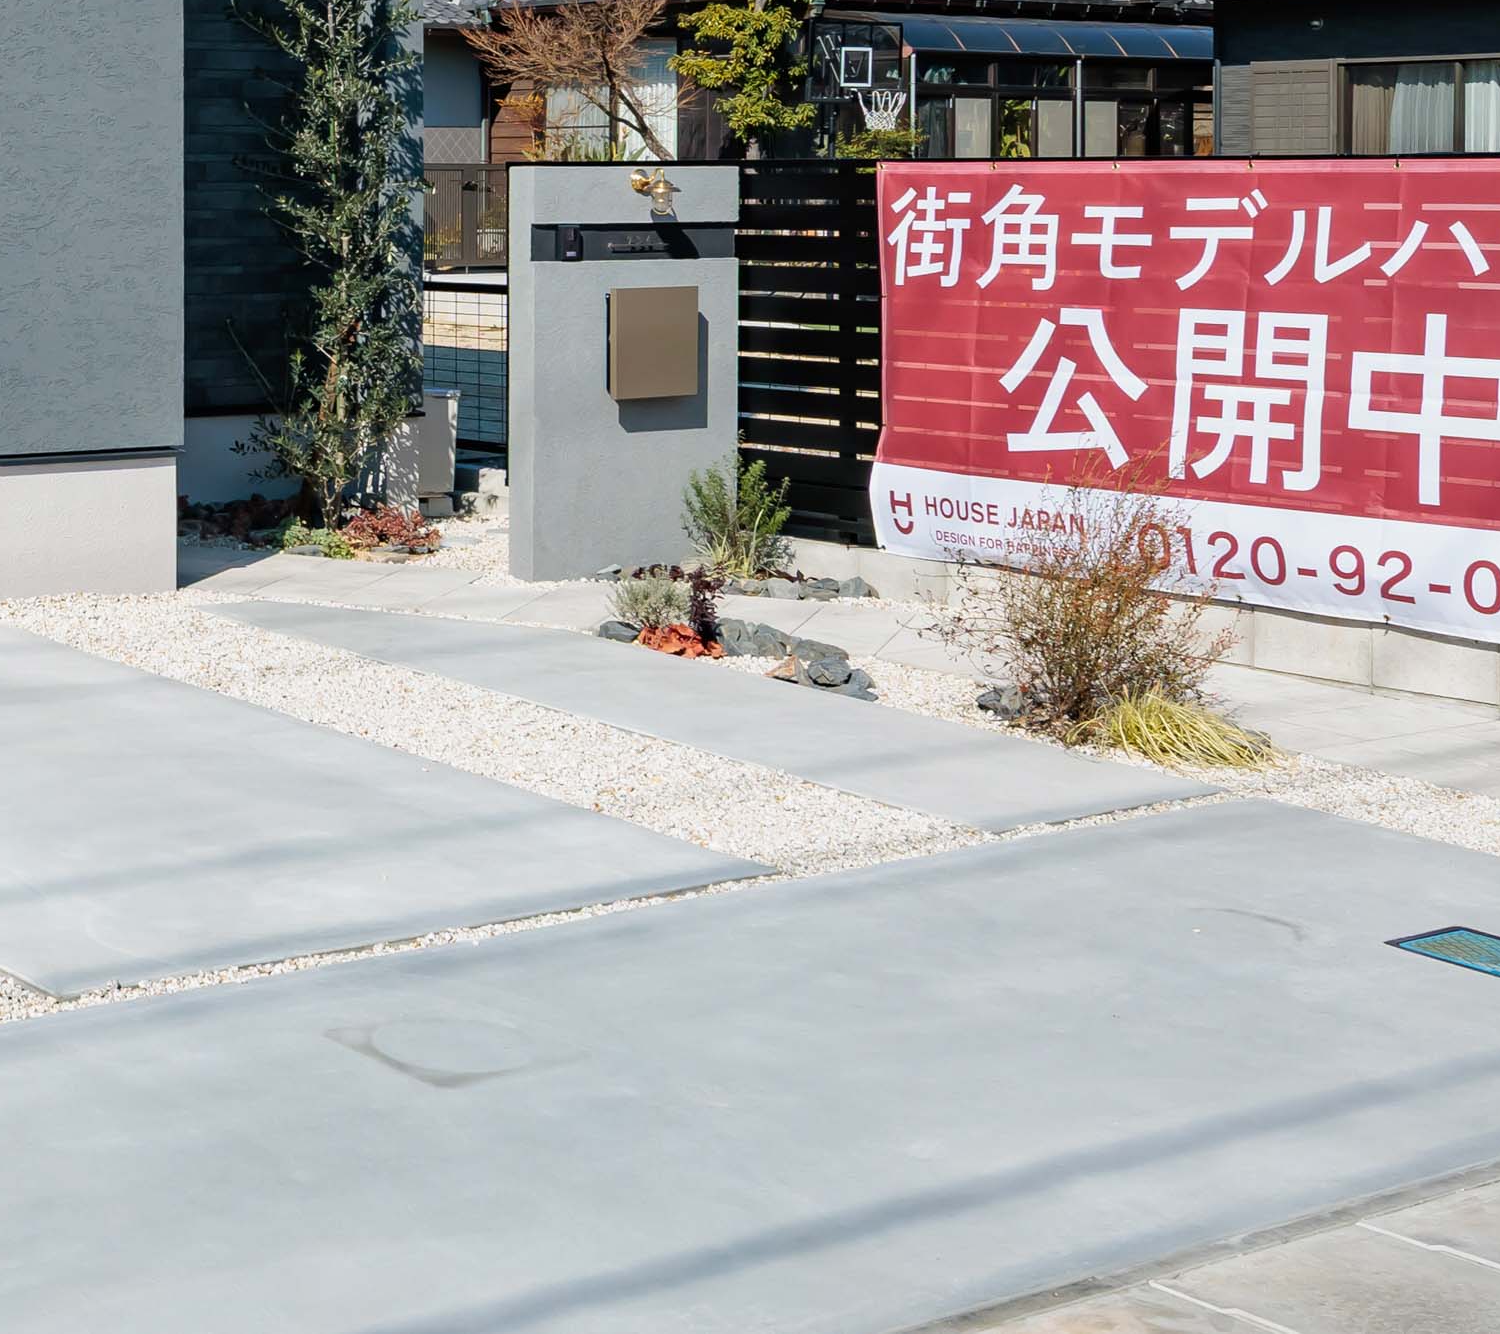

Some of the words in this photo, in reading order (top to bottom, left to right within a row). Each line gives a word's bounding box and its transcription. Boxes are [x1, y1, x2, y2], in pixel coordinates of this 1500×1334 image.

[925, 495, 999, 525] HOUSE
[1007, 507, 1085, 535] JAPAN
[936, 530, 976, 547] DESIGN
[980, 537, 1003, 550] FOR
